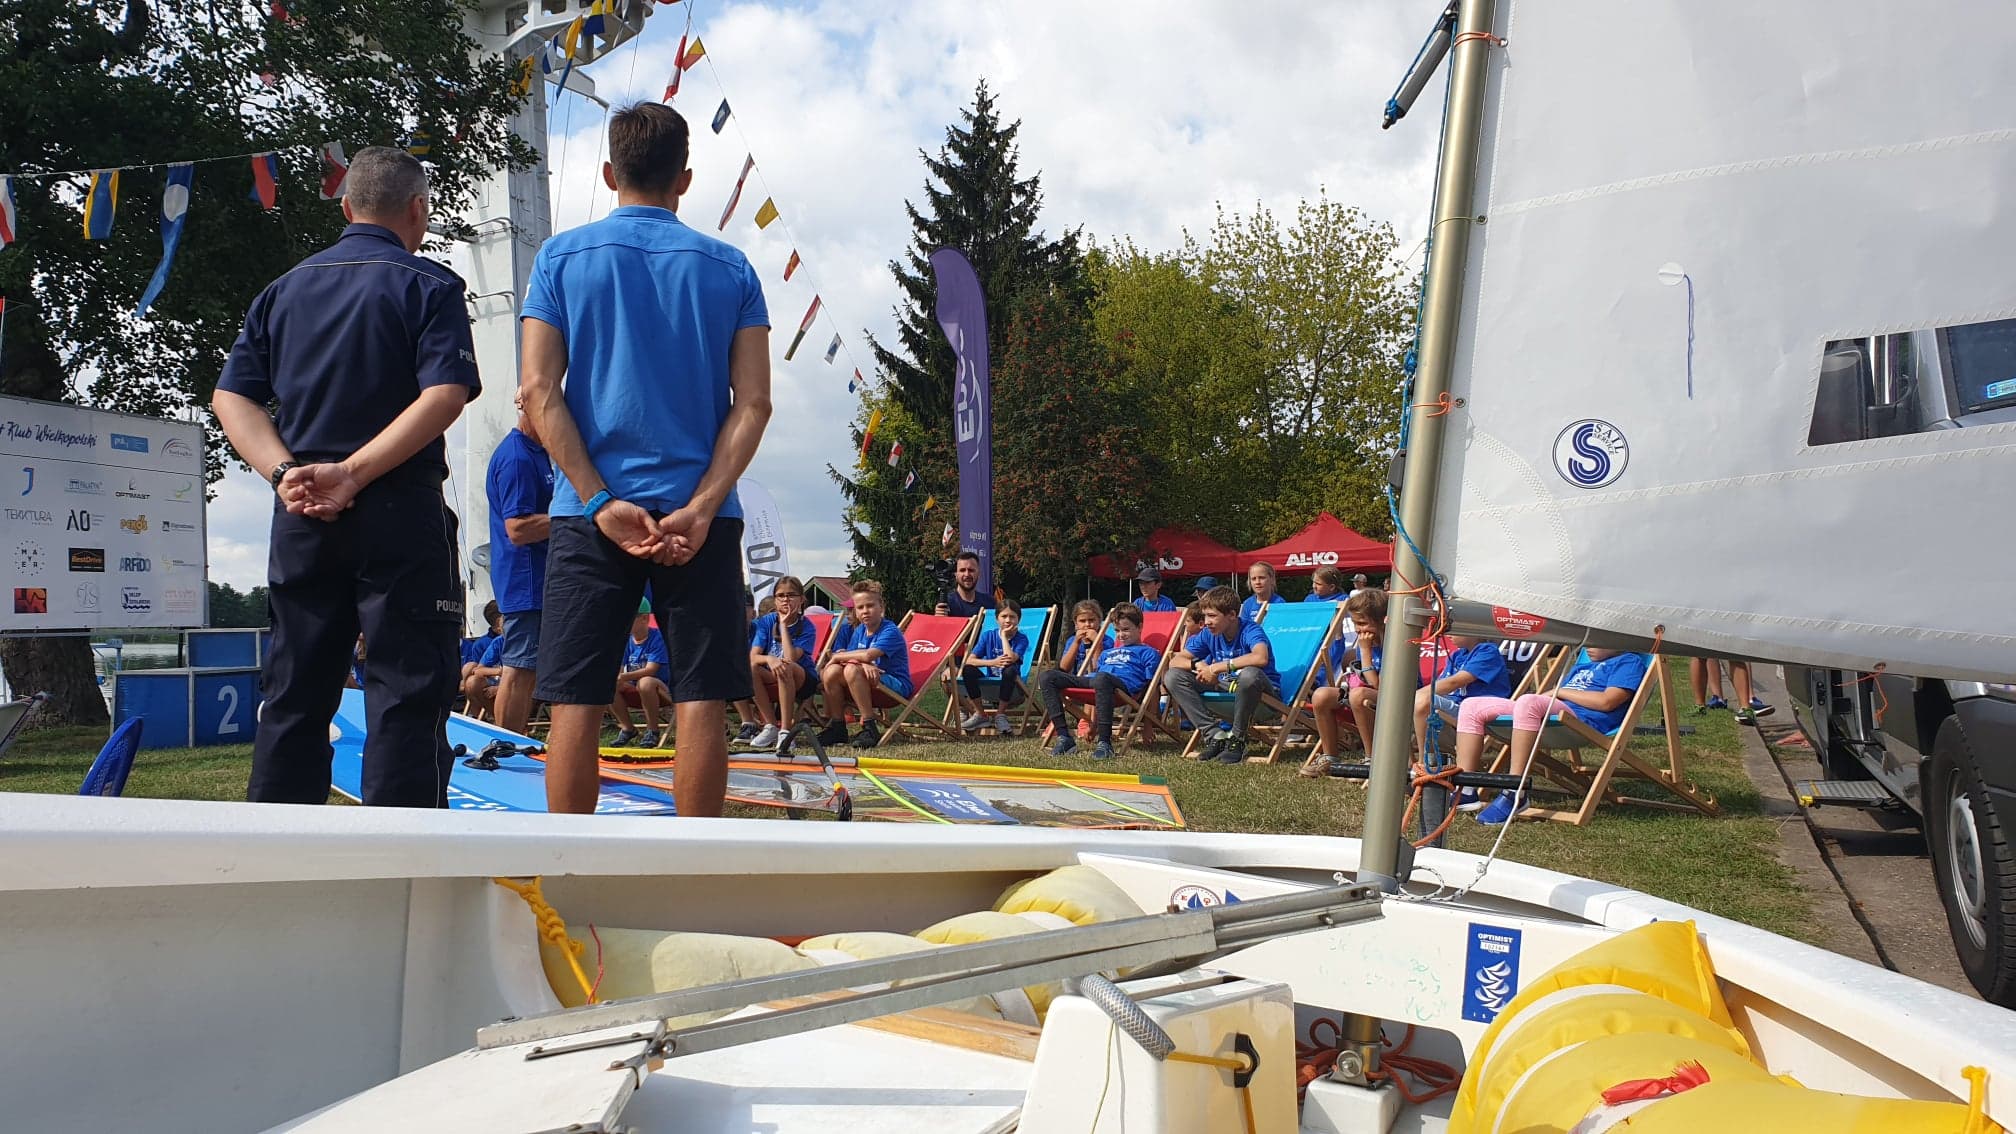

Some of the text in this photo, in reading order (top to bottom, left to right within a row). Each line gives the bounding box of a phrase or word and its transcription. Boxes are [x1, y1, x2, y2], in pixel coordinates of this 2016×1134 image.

[8, 421, 33, 440] Klub
[35, 424, 98, 448] Wielkopolski
[1595, 424, 1624, 454] SAIL
[115, 491, 151, 500] OPTIMAST
[1285, 551, 1338, 567] AL-KO
[1497, 616, 1541, 626] OPTIMAST
[911, 643, 941, 653] Enea
[217, 685, 239, 735] 2
[1477, 932, 1514, 944] OPTIMIST
